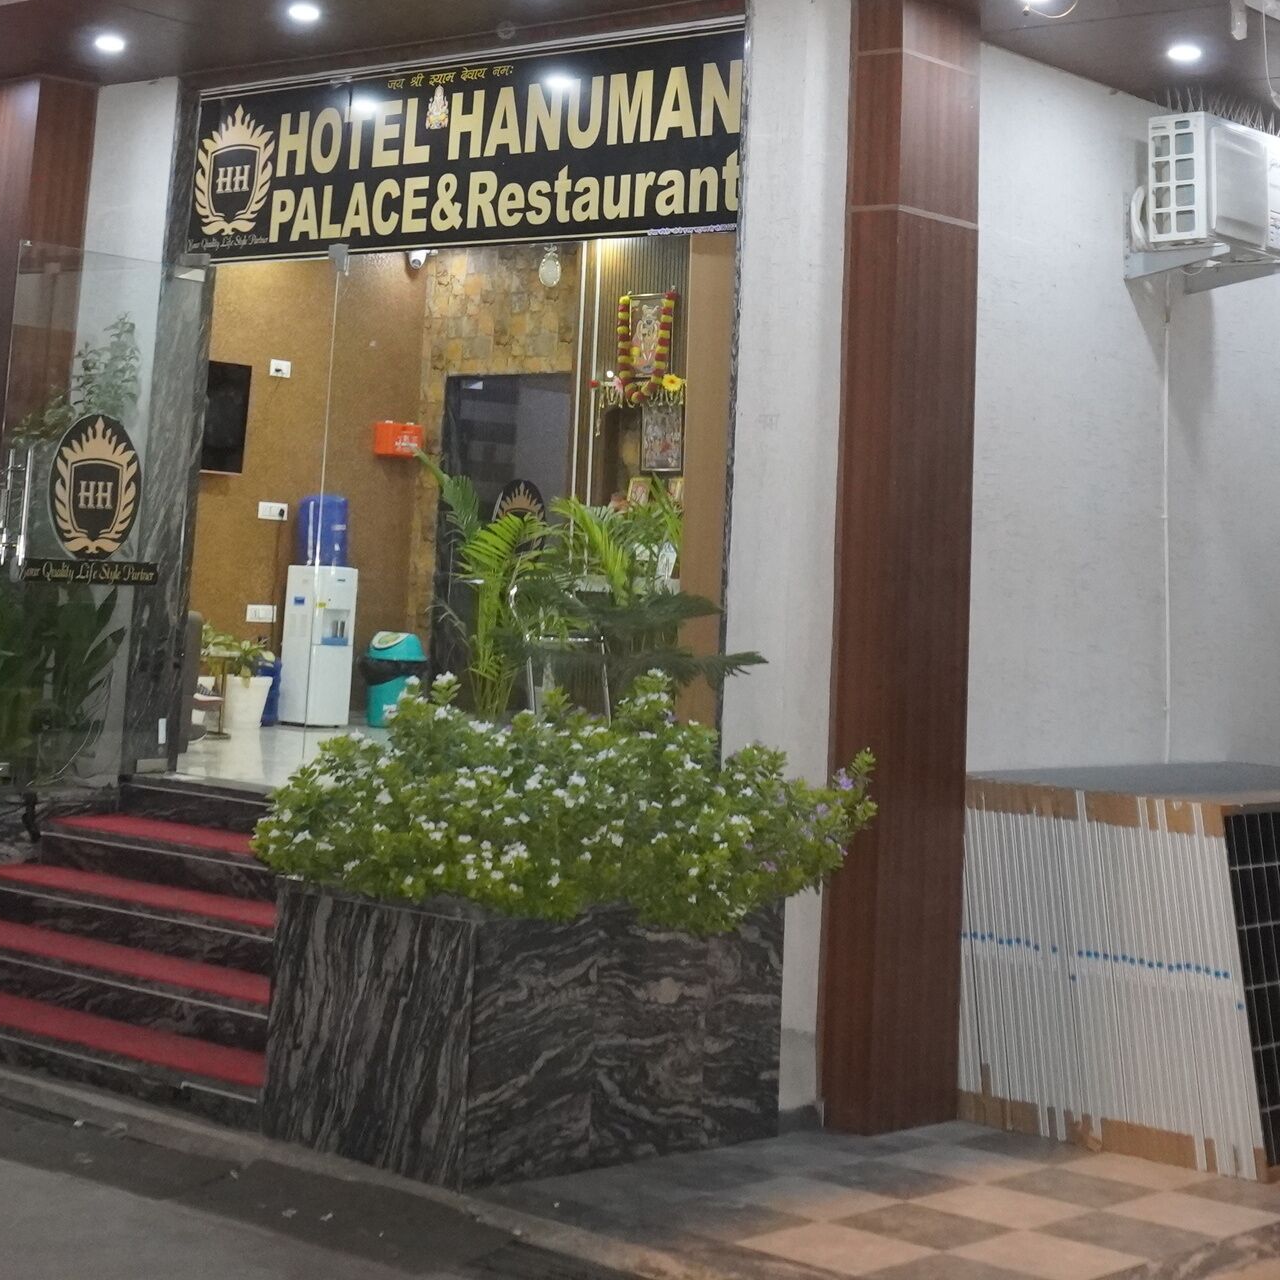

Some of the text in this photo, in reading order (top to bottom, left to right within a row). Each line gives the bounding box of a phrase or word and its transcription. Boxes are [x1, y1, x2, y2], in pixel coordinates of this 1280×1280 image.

[387, 78, 405, 90] जय
[410, 72, 425, 87] श्री
[461, 66, 488, 81] देवाय
[275, 59, 743, 178] HOTEL HANUMAN
[215, 164, 251, 194] HH
[78, 480, 114, 509] HH
[42, 561, 74, 584] Quality
[76, 562, 97, 584] Life
[98, 563, 120, 583] Style
[123, 564, 155, 581] Partner
